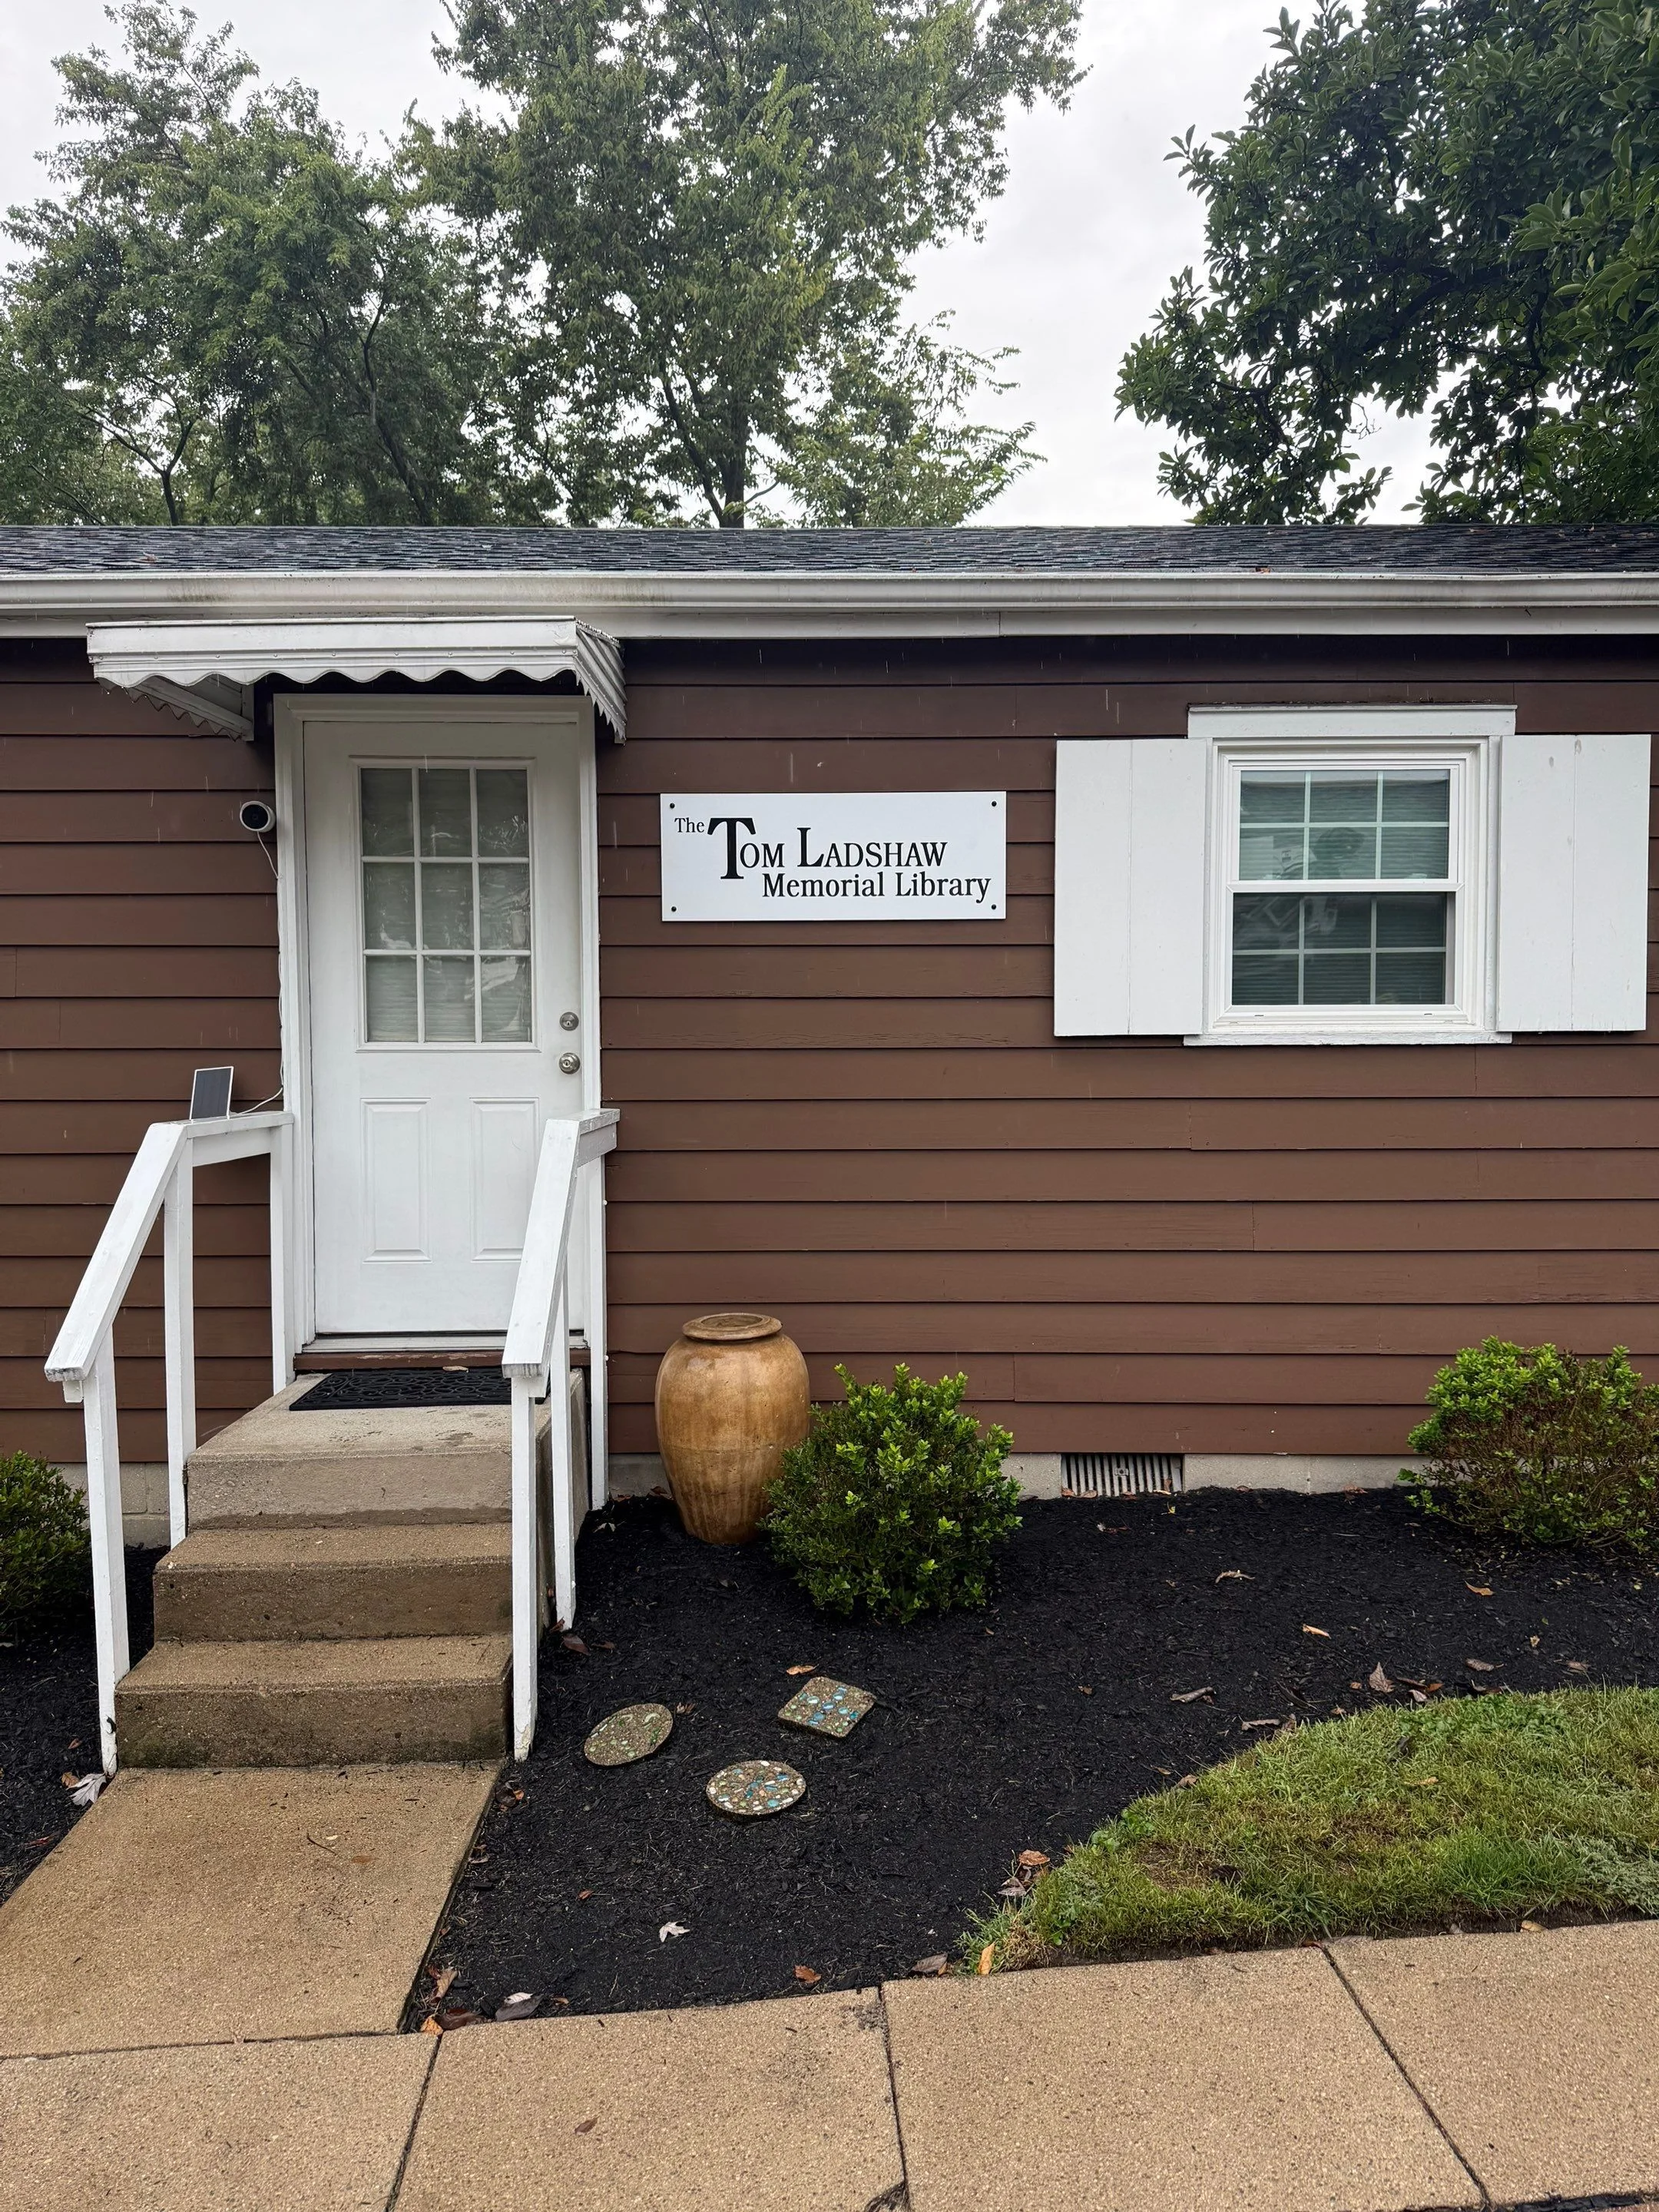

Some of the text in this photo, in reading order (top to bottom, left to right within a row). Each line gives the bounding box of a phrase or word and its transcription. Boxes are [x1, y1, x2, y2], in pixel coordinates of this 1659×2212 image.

[674, 816, 948, 880] The TOM LADSHAW
[762, 870, 992, 904] Memorial Library
